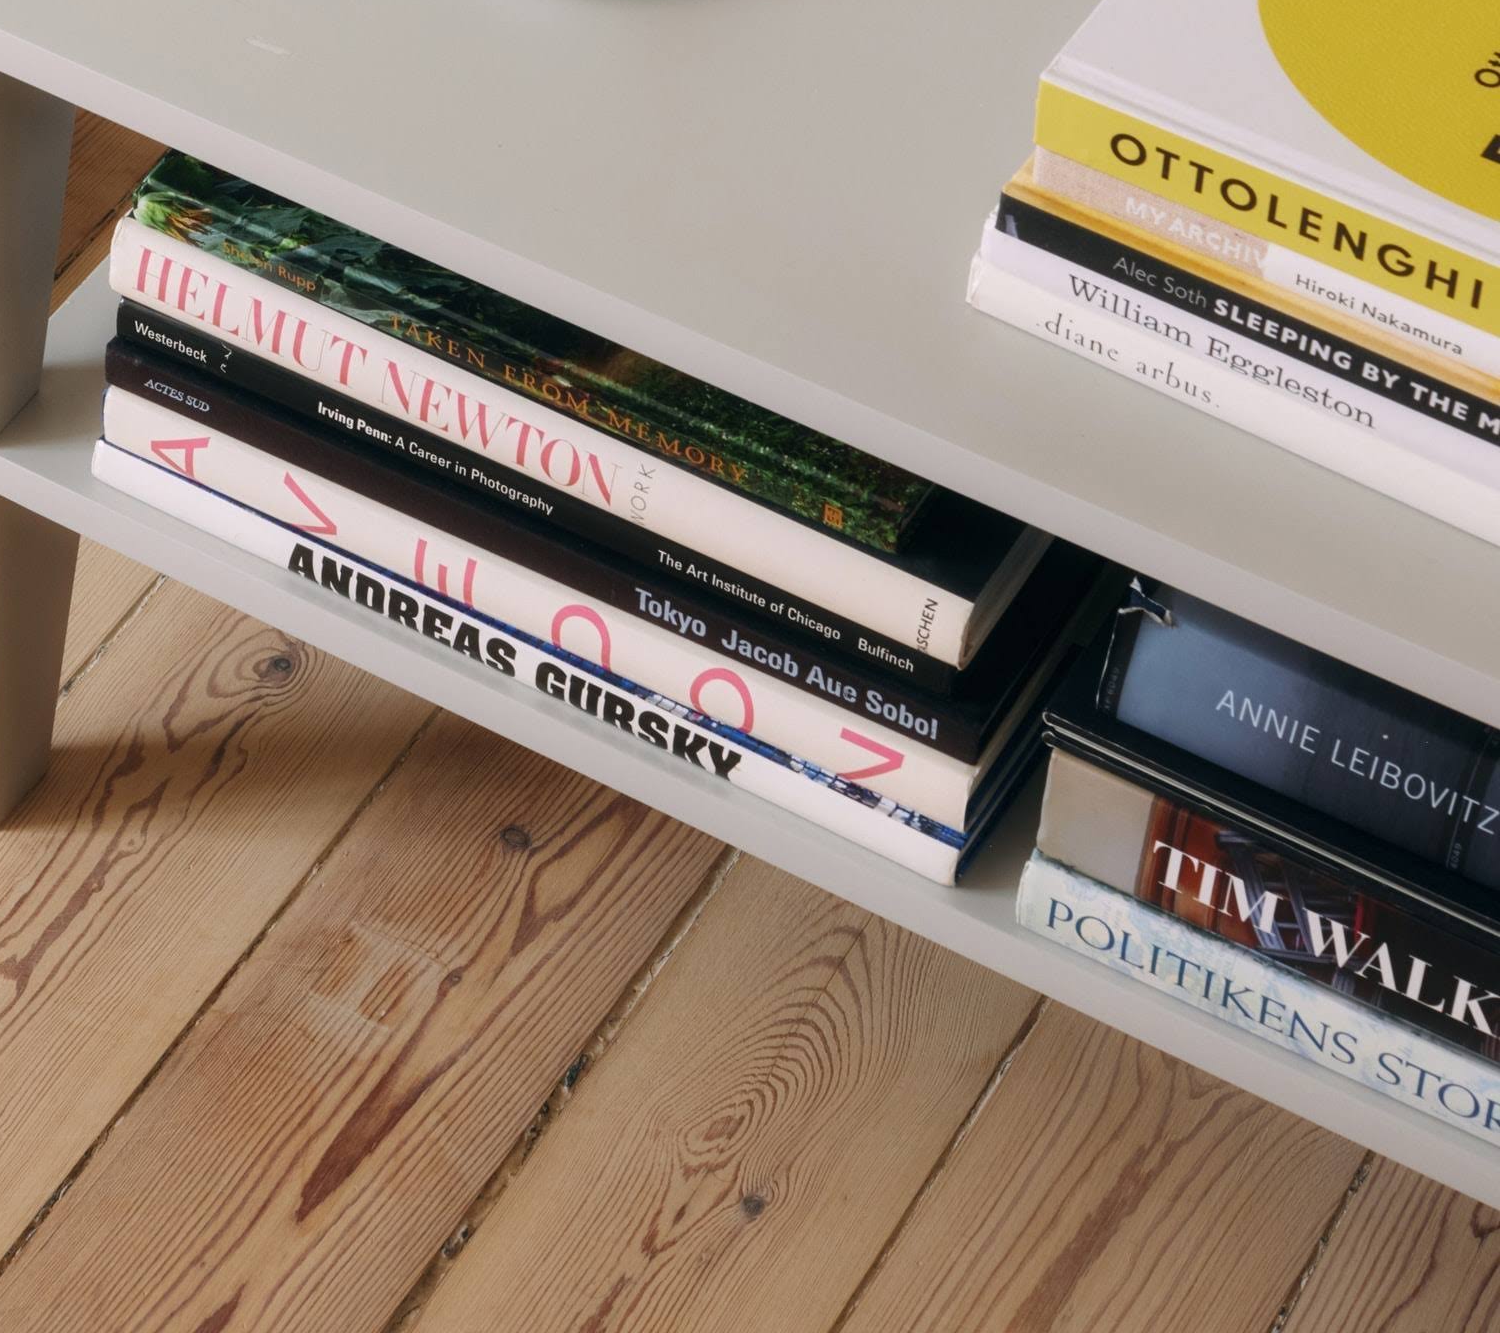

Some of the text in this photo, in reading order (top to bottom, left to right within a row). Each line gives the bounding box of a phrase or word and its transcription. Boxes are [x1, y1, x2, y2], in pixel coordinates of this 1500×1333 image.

[1109, 132, 1483, 310] OTTOLENGHI
[1125, 196, 1167, 225] MY
[278, 265, 316, 292] Rupp
[1295, 273, 1463, 356] Hiroki Nakamura
[133, 244, 623, 508] HELMUT NEWTON
[134, 319, 208, 365] Westerbeck
[144, 378, 210, 413] ACTES SUD
[1068, 273, 1376, 429] William Eggleston
[1113, 256, 1158, 289] Alec
[1163, 276, 1208, 309] Soth
[1213, 298, 1352, 371] SLEEPING
[1362, 362, 1400, 389] BY
[1410, 381, 1469, 421] THE
[389, 315, 750, 484] TAKEN FROM MEMORY
[317, 400, 554, 517] Irving Penn: A Career in Photography
[635, 586, 707, 638] Tokyo
[658, 549, 841, 641] The Art Institute of Chicago
[287, 543, 741, 782] ANDREAS GURSKY
[721, 628, 938, 740] Jacob Aue Sobol
[857, 636, 915, 673] Bulfinch
[1216, 690, 1500, 835] ANNIE LEIBOVITZ
[1046, 896, 1359, 1066] POLITIKENS
[1152, 839, 1500, 1039] TIM WALK
